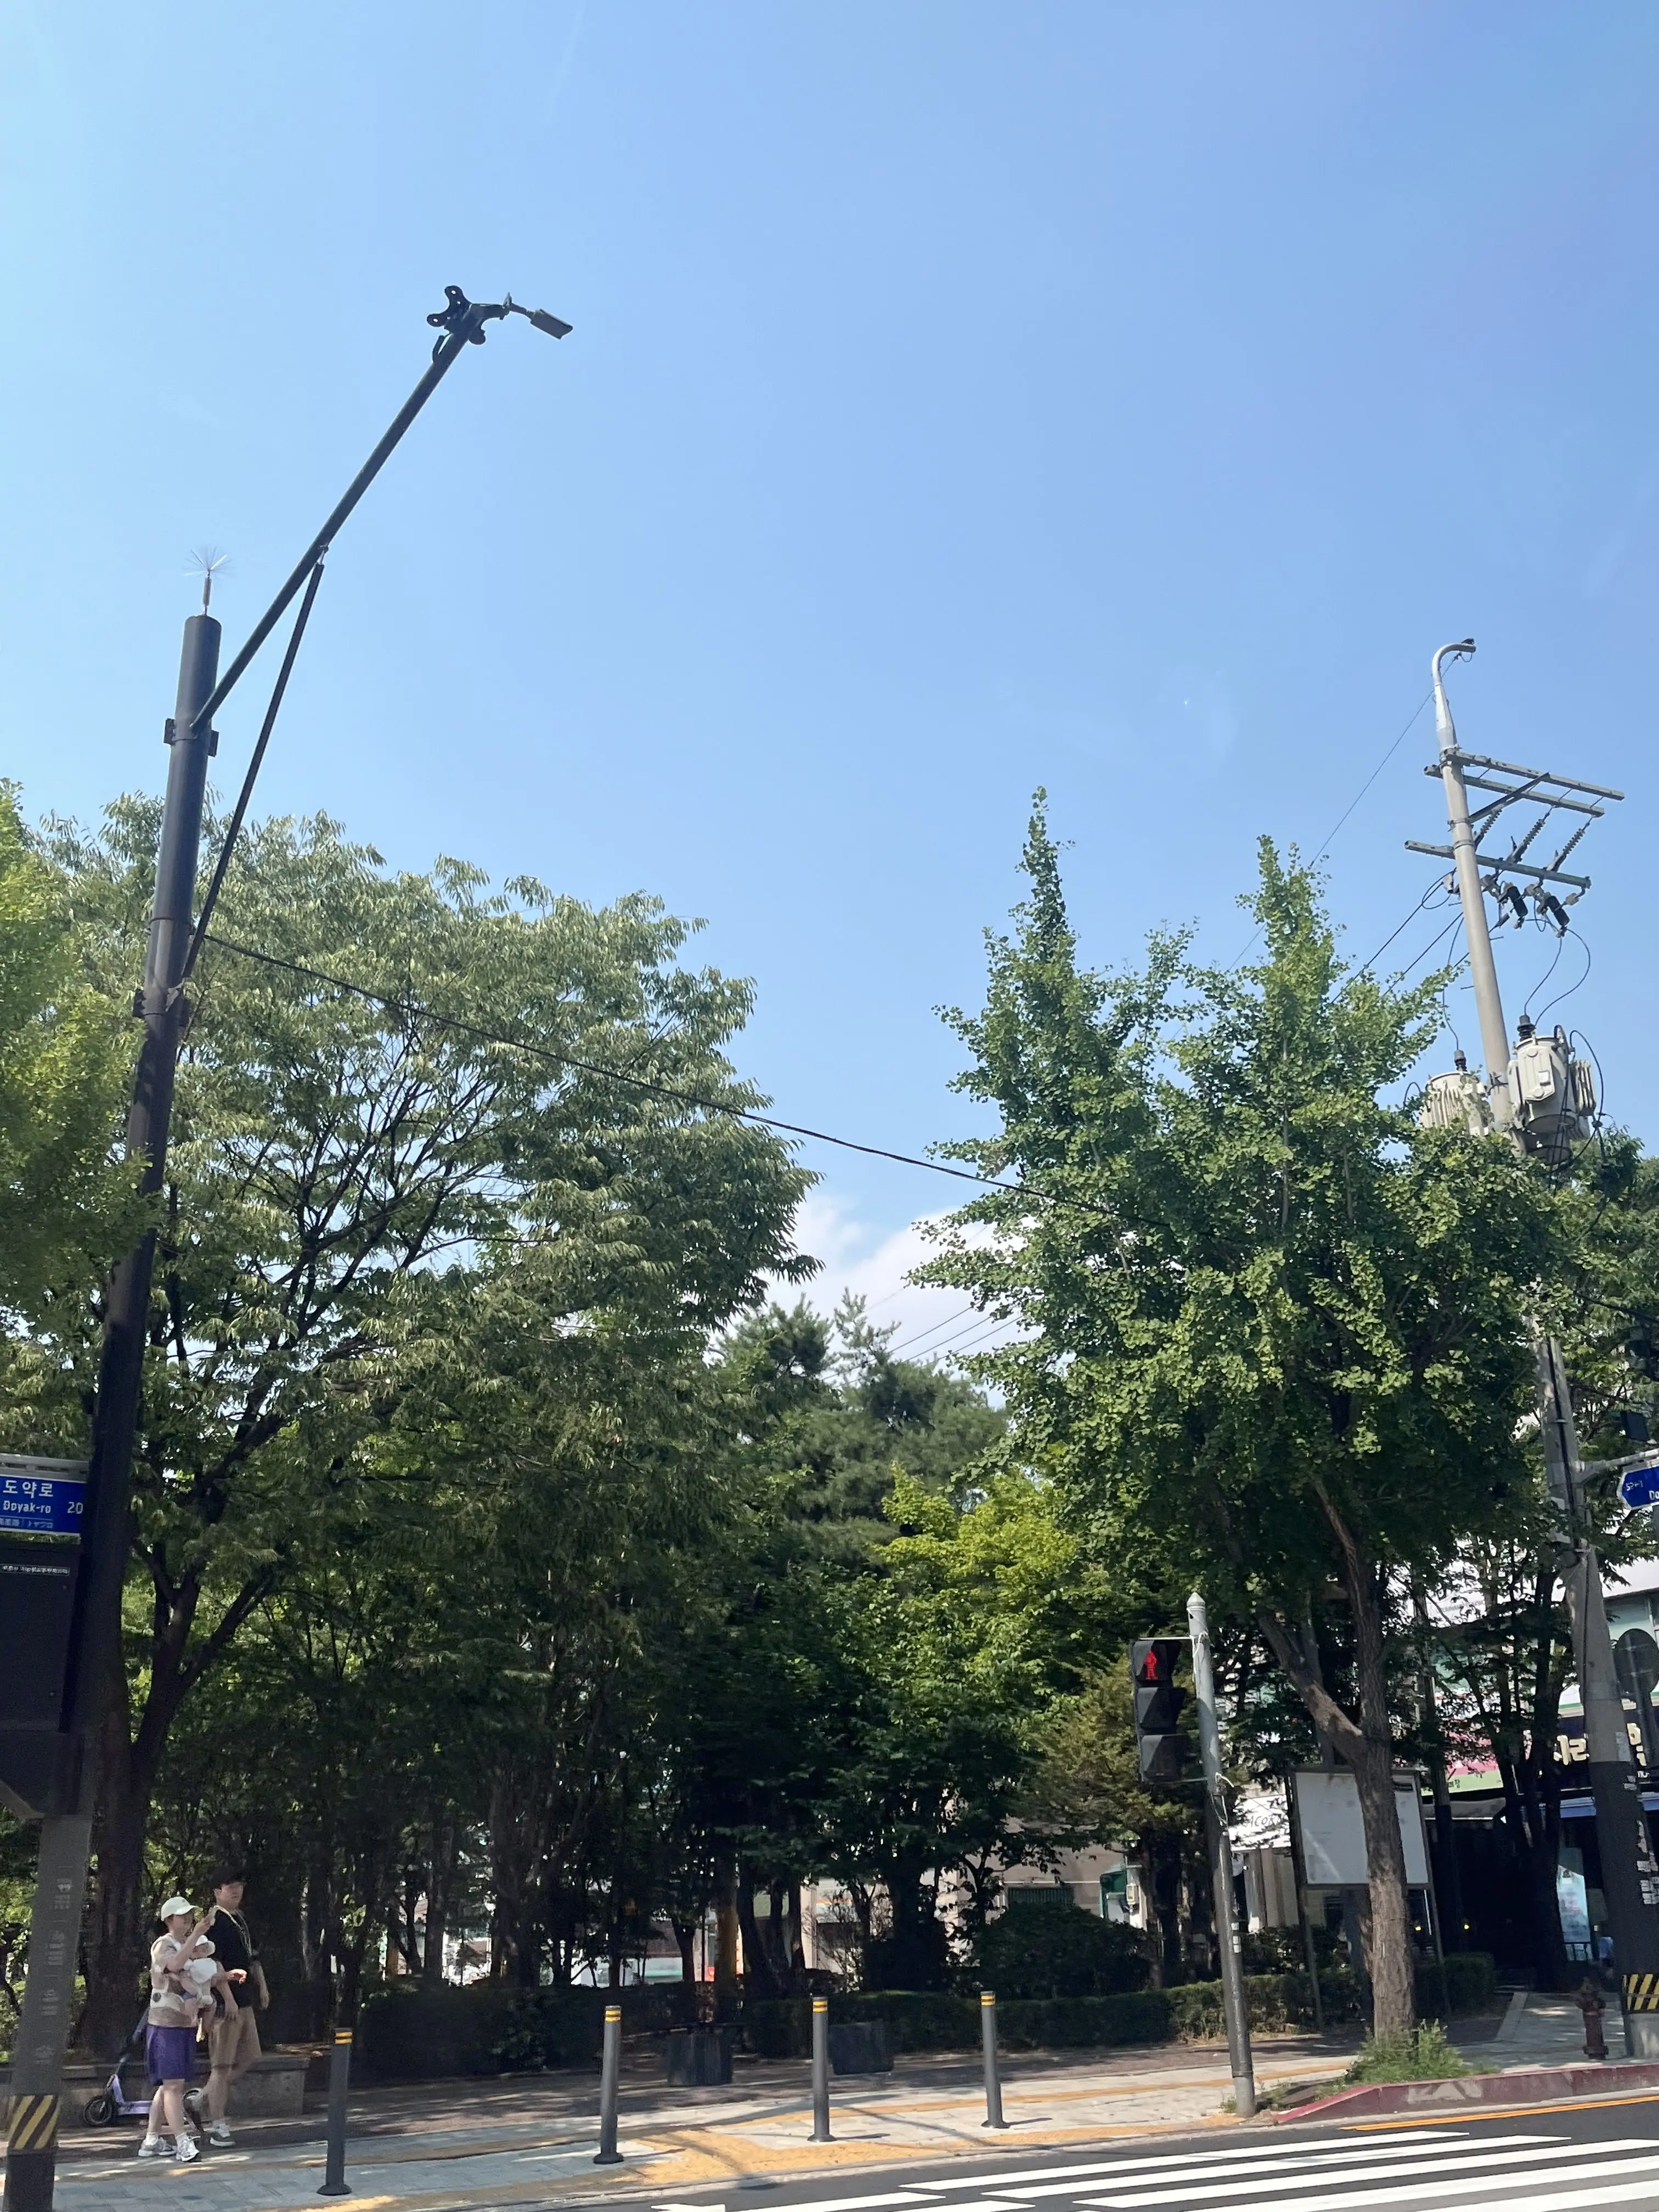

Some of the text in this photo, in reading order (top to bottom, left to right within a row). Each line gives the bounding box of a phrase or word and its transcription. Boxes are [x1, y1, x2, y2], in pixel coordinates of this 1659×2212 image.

[2, 1480, 54, 1499] 도약로
[3, 1500, 52, 1514] Doyak-ro
[67, 1502, 83, 1514] 20
